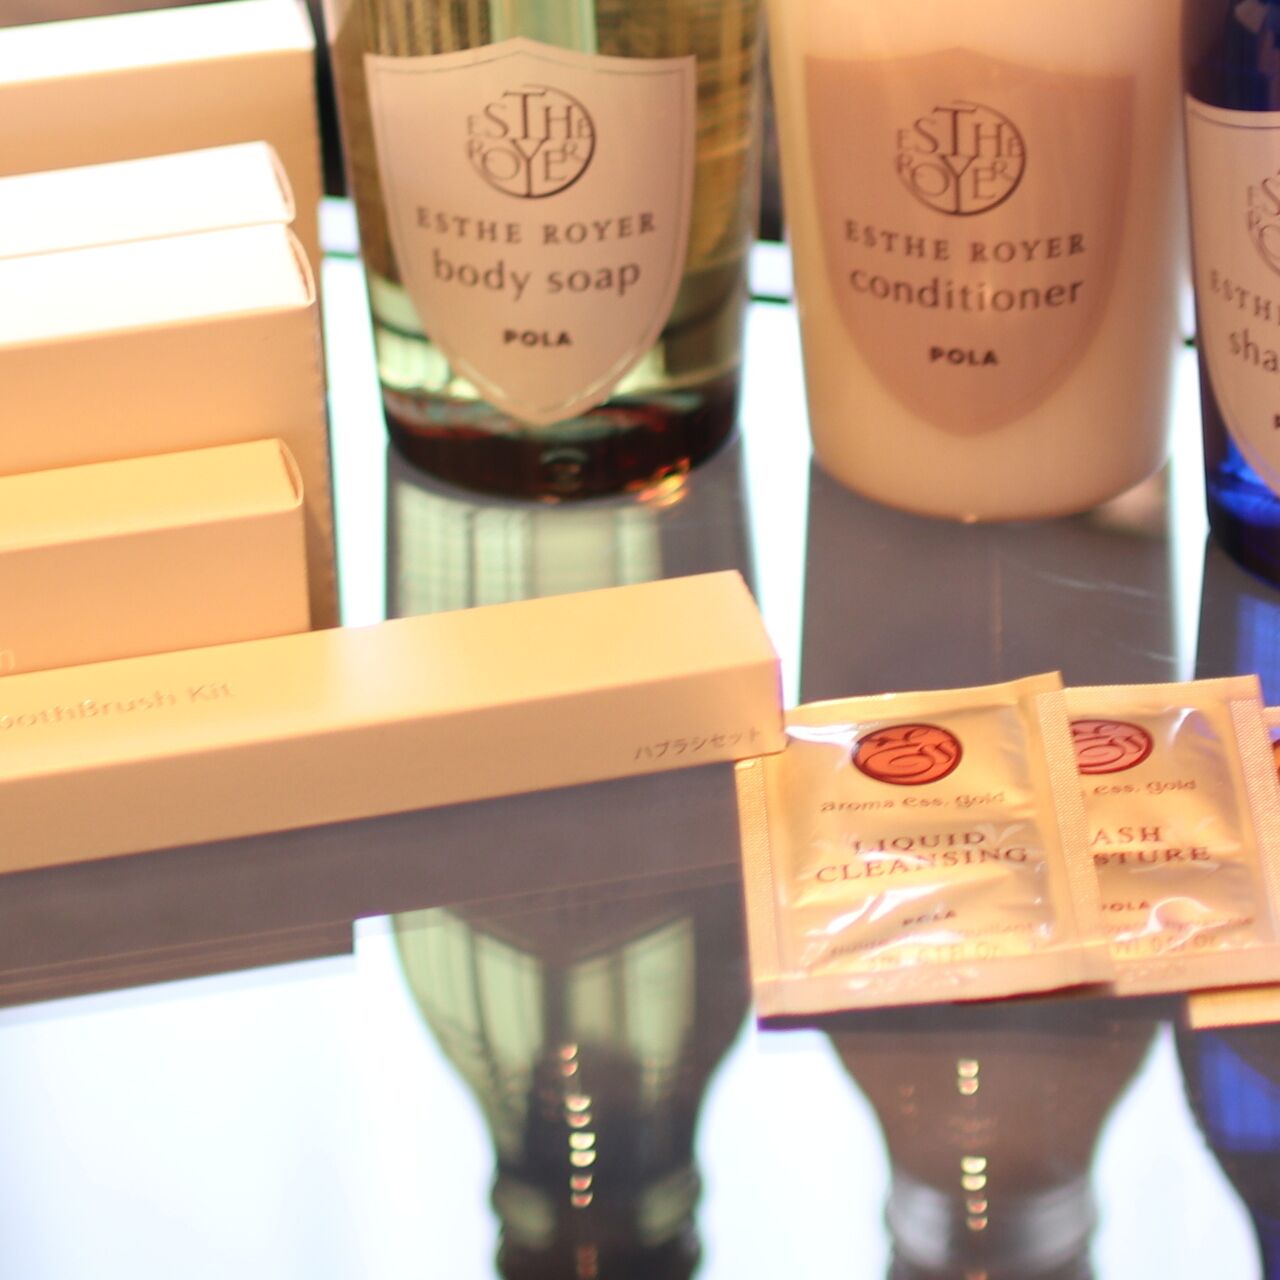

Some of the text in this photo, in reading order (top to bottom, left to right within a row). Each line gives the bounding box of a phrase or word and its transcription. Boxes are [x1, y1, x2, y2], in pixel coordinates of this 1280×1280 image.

[416, 207, 656, 245] ESTHE ROYER
[844, 219, 1087, 263] ESTHE ROYER
[432, 249, 642, 302] body soap
[848, 269, 1084, 312] conditioner
[503, 328, 573, 347] POLA
[928, 346, 1000, 366] POLA
[185, 680, 235, 702] Kit
[820, 799, 895, 814] aroma
[852, 831, 987, 855] LIQUID
[1091, 825, 1163, 846] ASH
[815, 846, 1029, 883] CLEANSING
